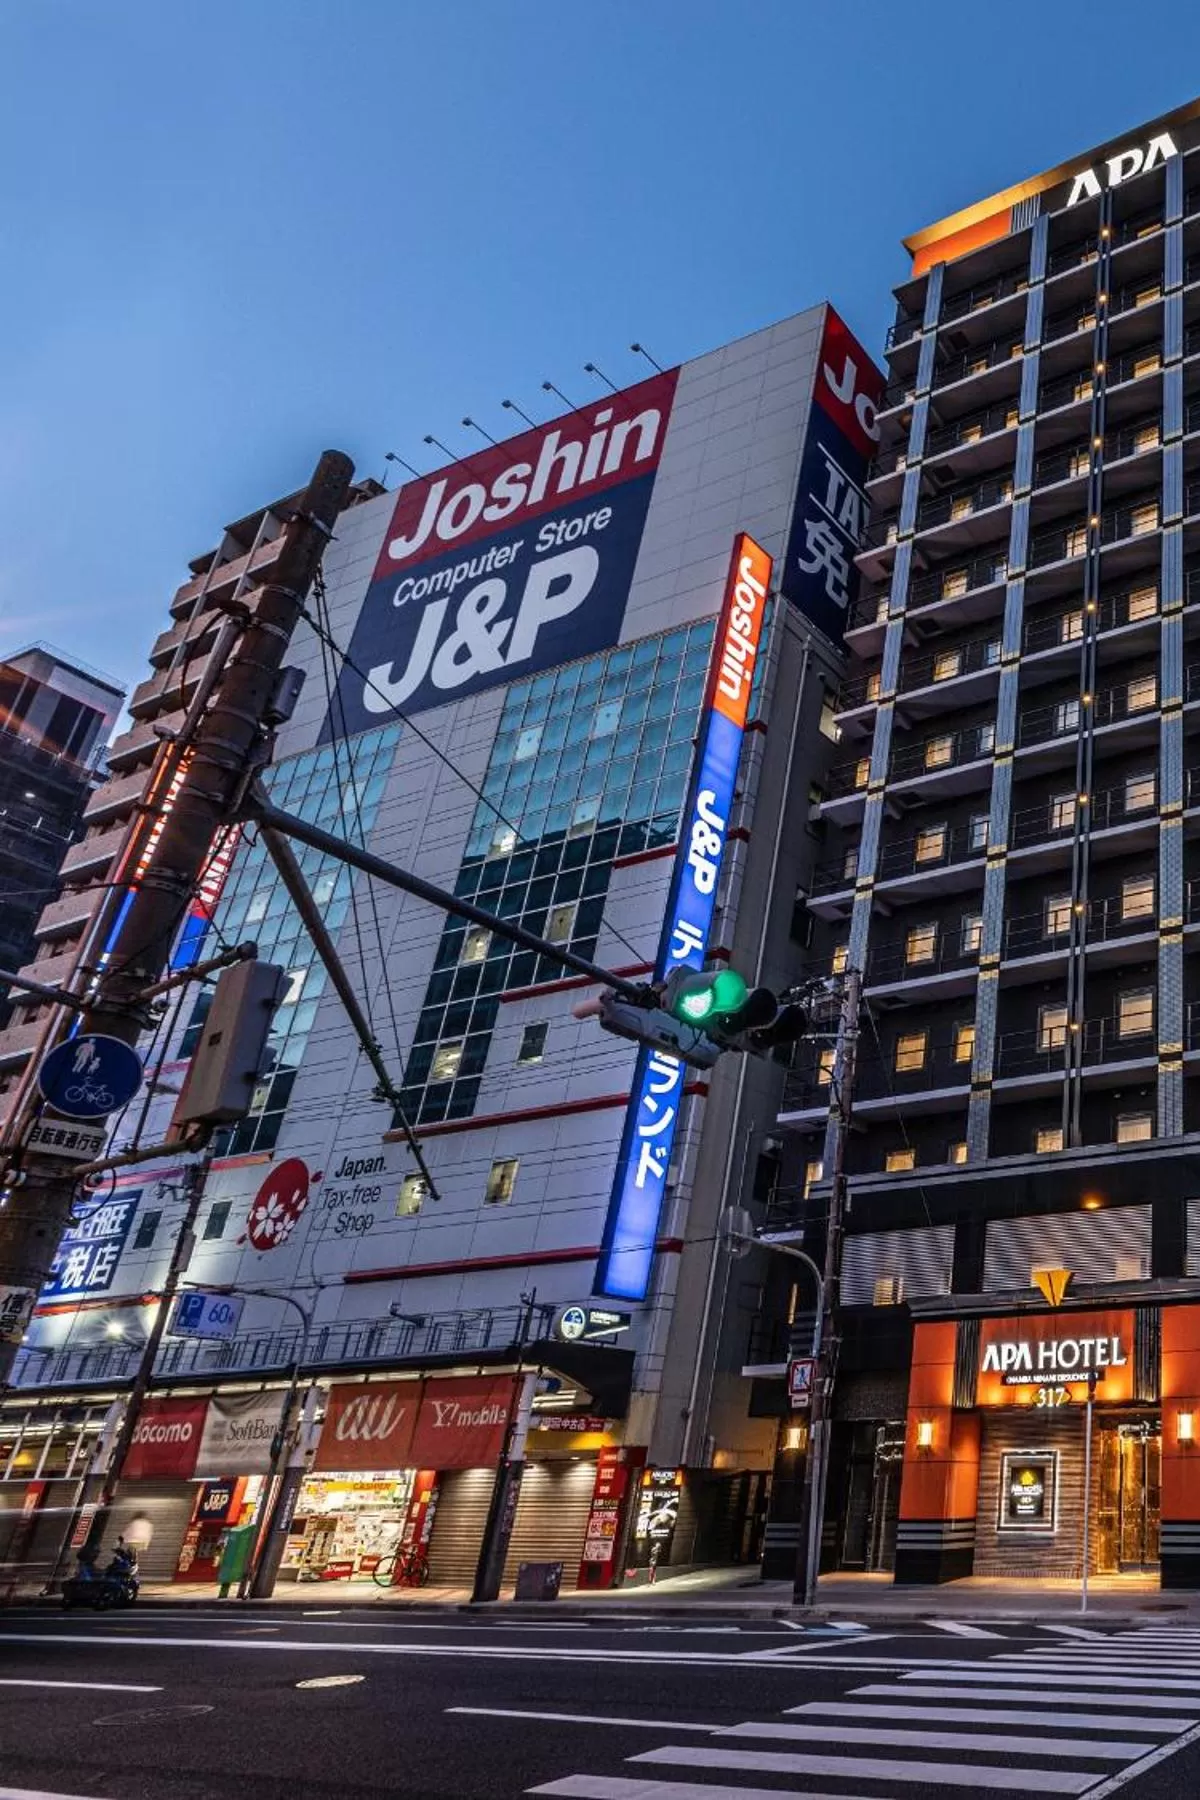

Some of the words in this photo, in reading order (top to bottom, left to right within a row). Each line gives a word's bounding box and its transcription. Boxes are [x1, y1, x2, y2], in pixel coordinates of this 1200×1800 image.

[1066, 132, 1178, 208] APA
[388, 407, 662, 560] Joshin
[393, 539, 523, 608] Computer
[534, 505, 612, 553] Store
[362, 545, 599, 714] J&P
[716, 556, 765, 702] Joshin
[688, 789, 724, 895] J&P
[28, 1126, 105, 1154] 自転車通行可
[324, 1184, 381, 1210] Tax-free
[334, 1212, 374, 1237] Shop
[982, 1343, 1033, 1371] APA
[1038, 1337, 1127, 1369] HOTEL
[1037, 1387, 1065, 1408] 317
[131, 1420, 193, 1444] docomo
[227, 1419, 281, 1441] SoftBan
[335, 1394, 405, 1441] au
[204, 1493, 229, 1511] J&P
